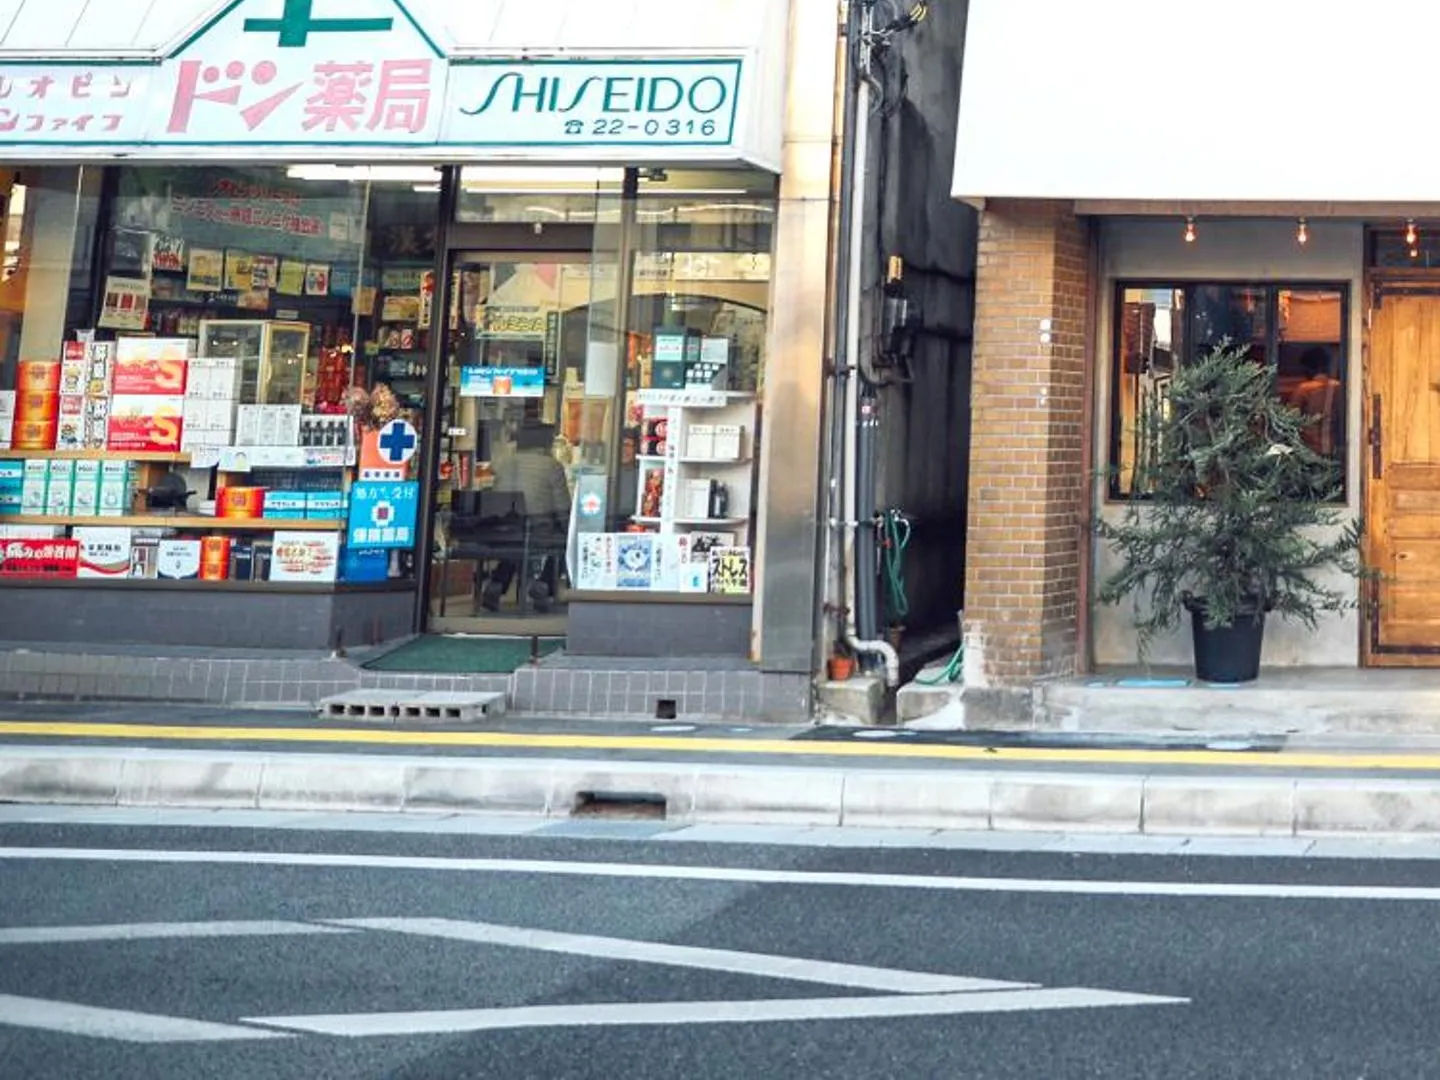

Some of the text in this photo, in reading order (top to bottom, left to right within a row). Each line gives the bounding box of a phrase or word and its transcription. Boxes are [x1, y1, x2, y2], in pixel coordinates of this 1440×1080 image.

[166, 57, 433, 135] ドン薬局
[458, 71, 728, 116] SHISEIDO
[591, 118, 716, 137] 22-0316
